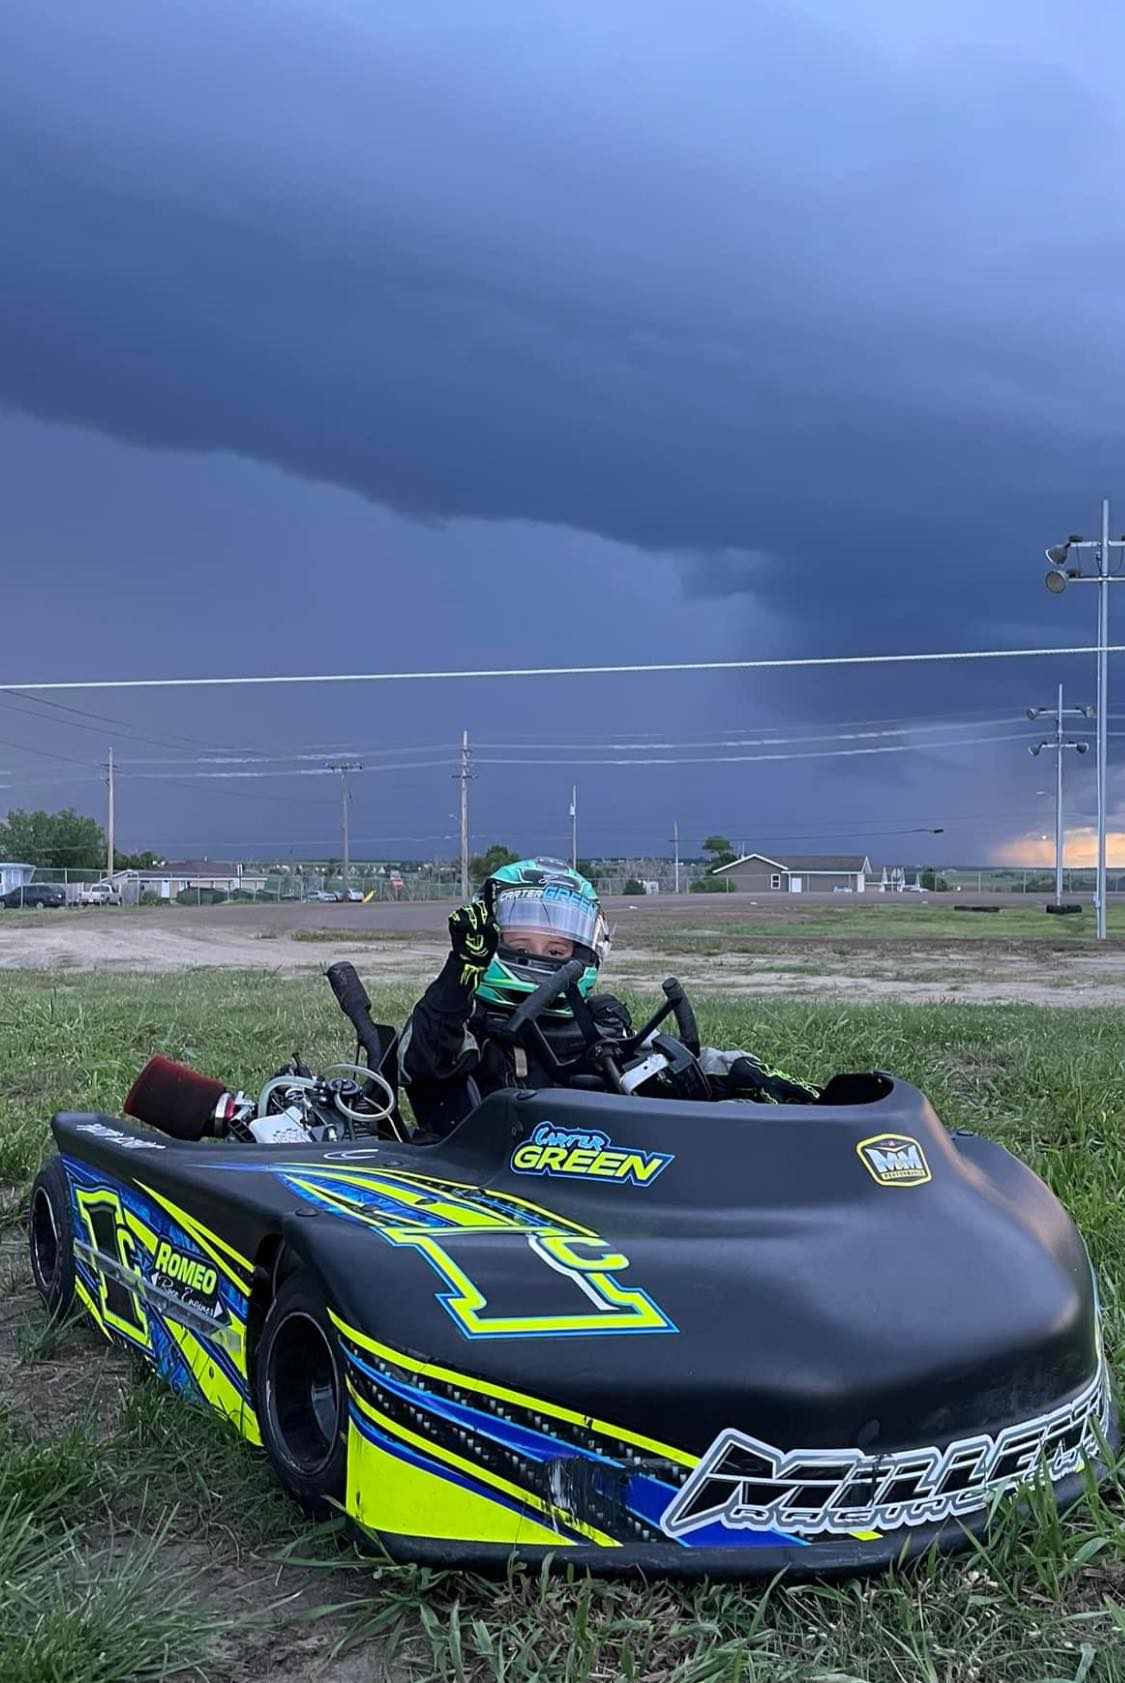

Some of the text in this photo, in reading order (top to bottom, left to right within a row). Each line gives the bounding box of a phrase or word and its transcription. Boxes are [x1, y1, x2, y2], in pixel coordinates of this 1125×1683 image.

[499, 884, 599, 918] CARTER GREEN
[534, 1127, 605, 1150] CARTER
[513, 1145, 663, 1181] GREEN
[155, 1241, 218, 1295] ROMEO
